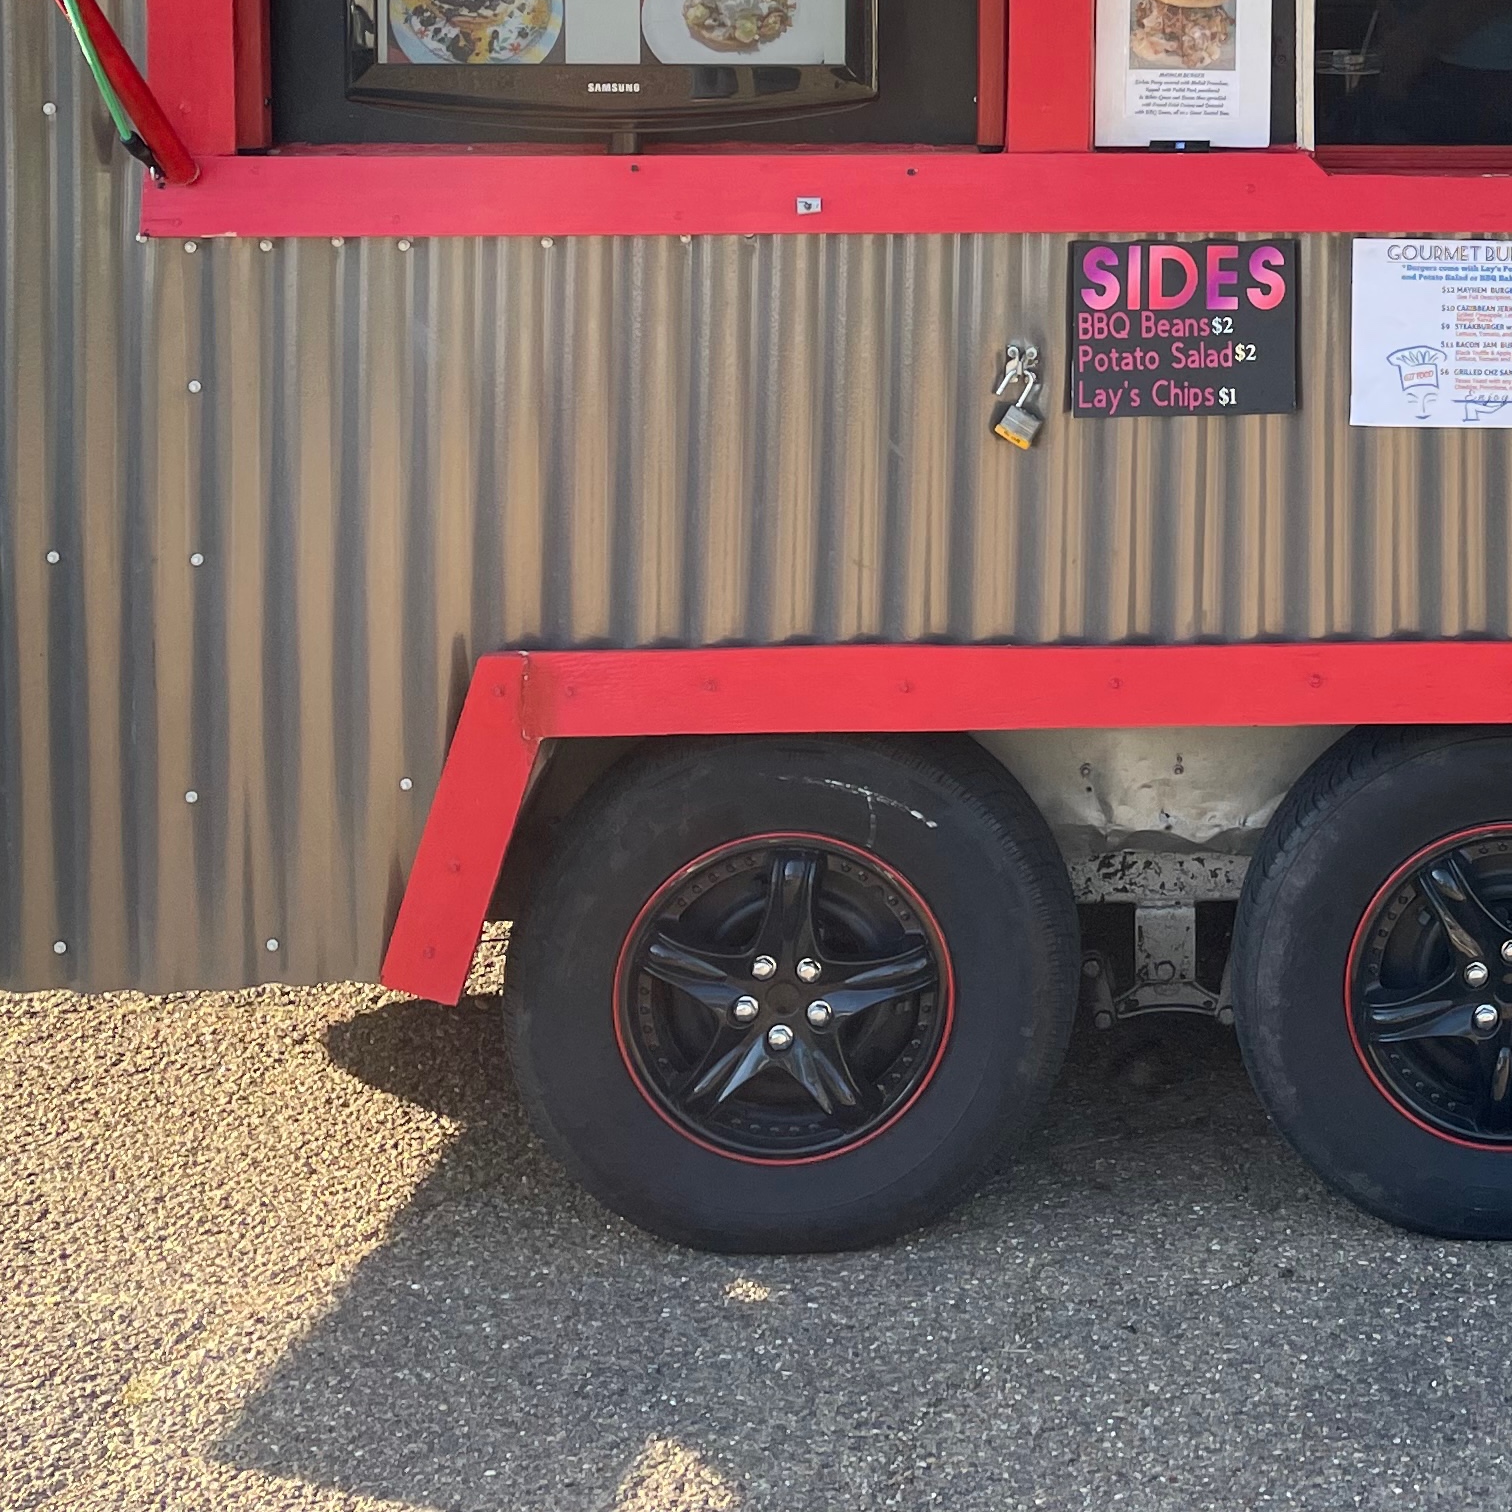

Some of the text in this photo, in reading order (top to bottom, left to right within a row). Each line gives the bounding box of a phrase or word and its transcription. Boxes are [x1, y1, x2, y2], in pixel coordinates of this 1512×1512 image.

[587, 82, 641, 94] SAMSUNG
[1387, 244, 1482, 262] GOURMET
[1080, 245, 1286, 311] SIDES
[1078, 311, 1234, 340] BBQ Beans $2
[1078, 340, 1257, 373] Potato Salad $2
[1078, 379, 1237, 415] Lay's Chips $1
